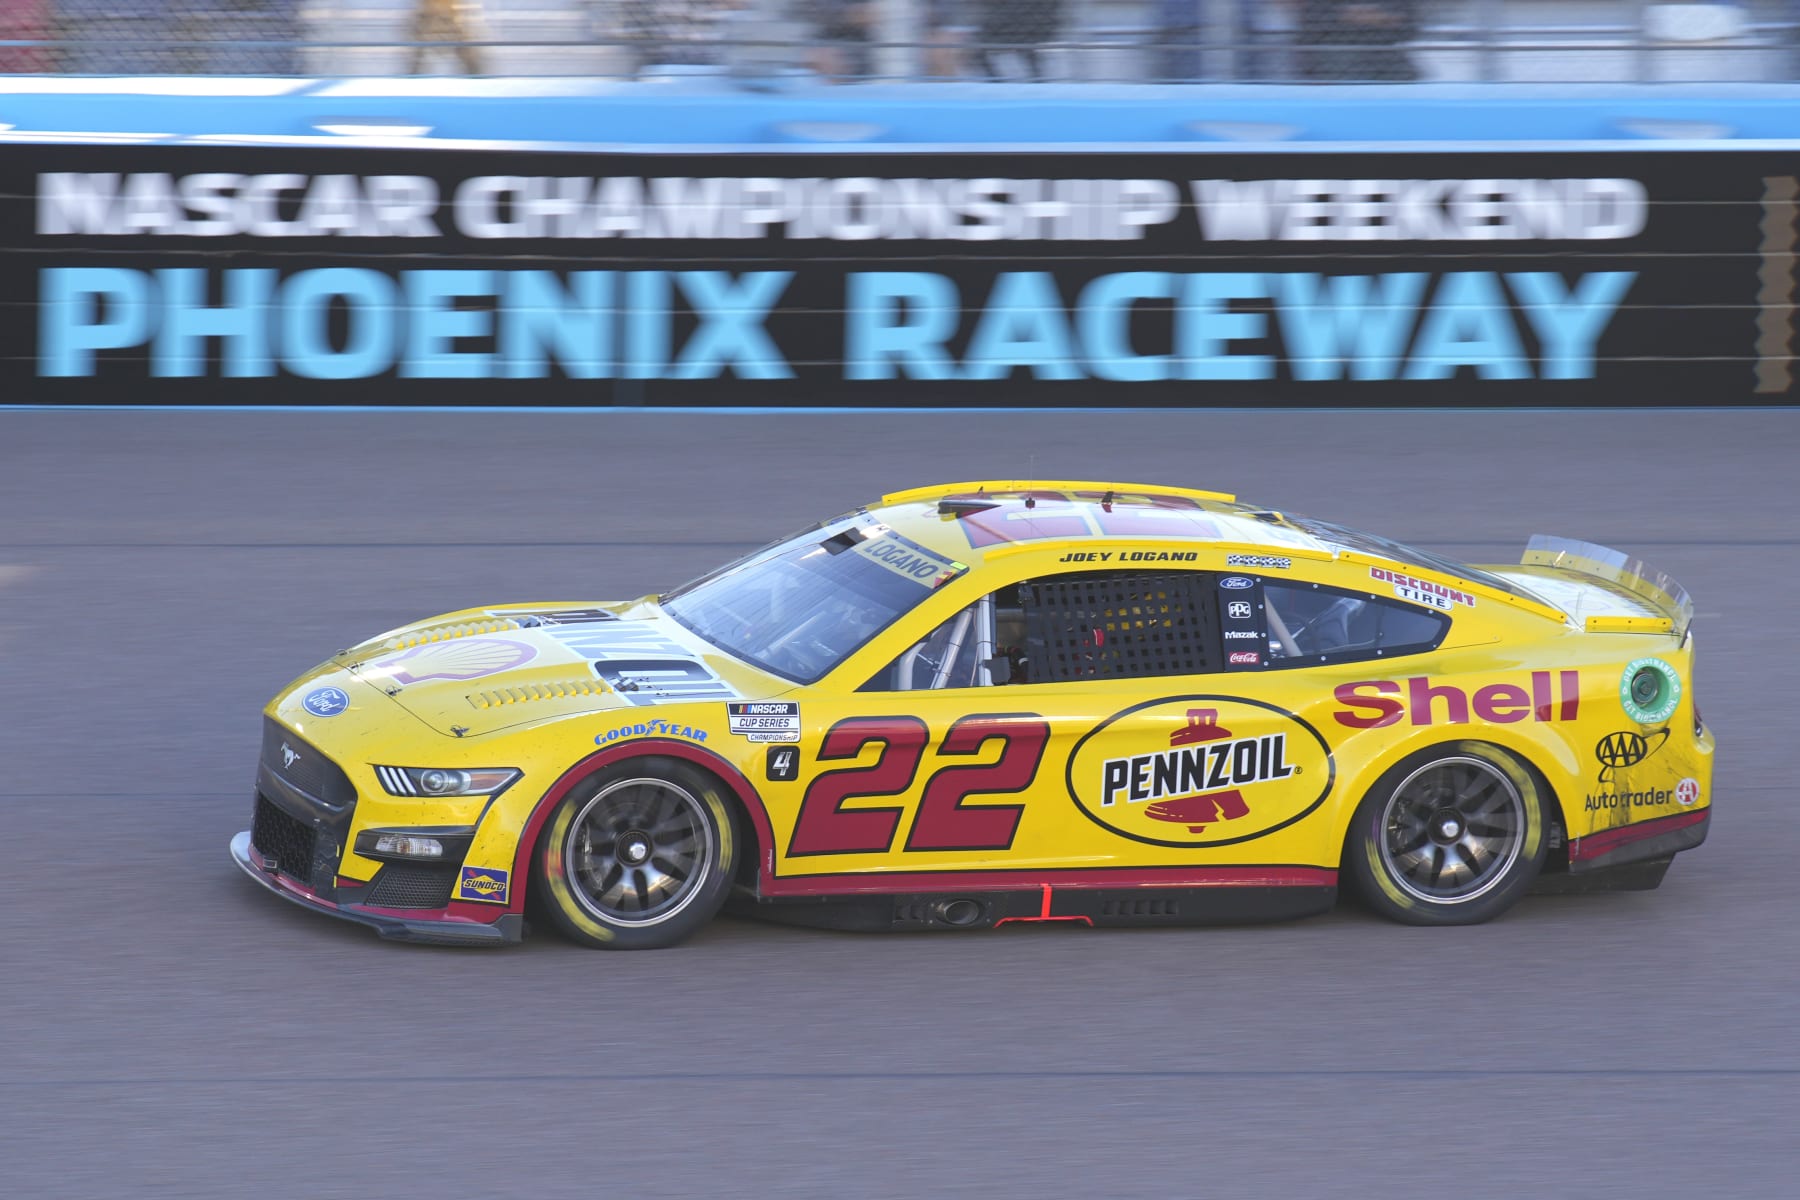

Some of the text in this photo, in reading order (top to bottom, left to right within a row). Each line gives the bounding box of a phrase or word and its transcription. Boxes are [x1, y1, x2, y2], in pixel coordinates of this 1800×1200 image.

[36, 172, 1649, 241] NASCAR CHAMPIONSHIP WEEKEND
[37, 267, 1639, 382] PHOENIX RACEWAY
[864, 540, 939, 578] LOGANO
[1059, 552, 1198, 562] JOEY LOGANO
[1371, 567, 1474, 607] DISCOUNT
[1401, 588, 1445, 607] TIRE
[1230, 604, 1250, 616] PPG
[1225, 631, 1258, 639] Mazak
[308, 689, 341, 712] Ford
[751, 704, 788, 714] NASCAR
[1333, 670, 1579, 729] Shell
[594, 719, 708, 745] GOODYEAR
[740, 719, 790, 728] CUP SERIES
[1599, 733, 1645, 767] AAA
[773, 751, 792, 777] 4
[1102, 733, 1296, 807] PENNZOIL
[785, 712, 1050, 858] 22
[1584, 786, 1673, 812] Autotrader
[464, 879, 505, 892] SUNOCO
